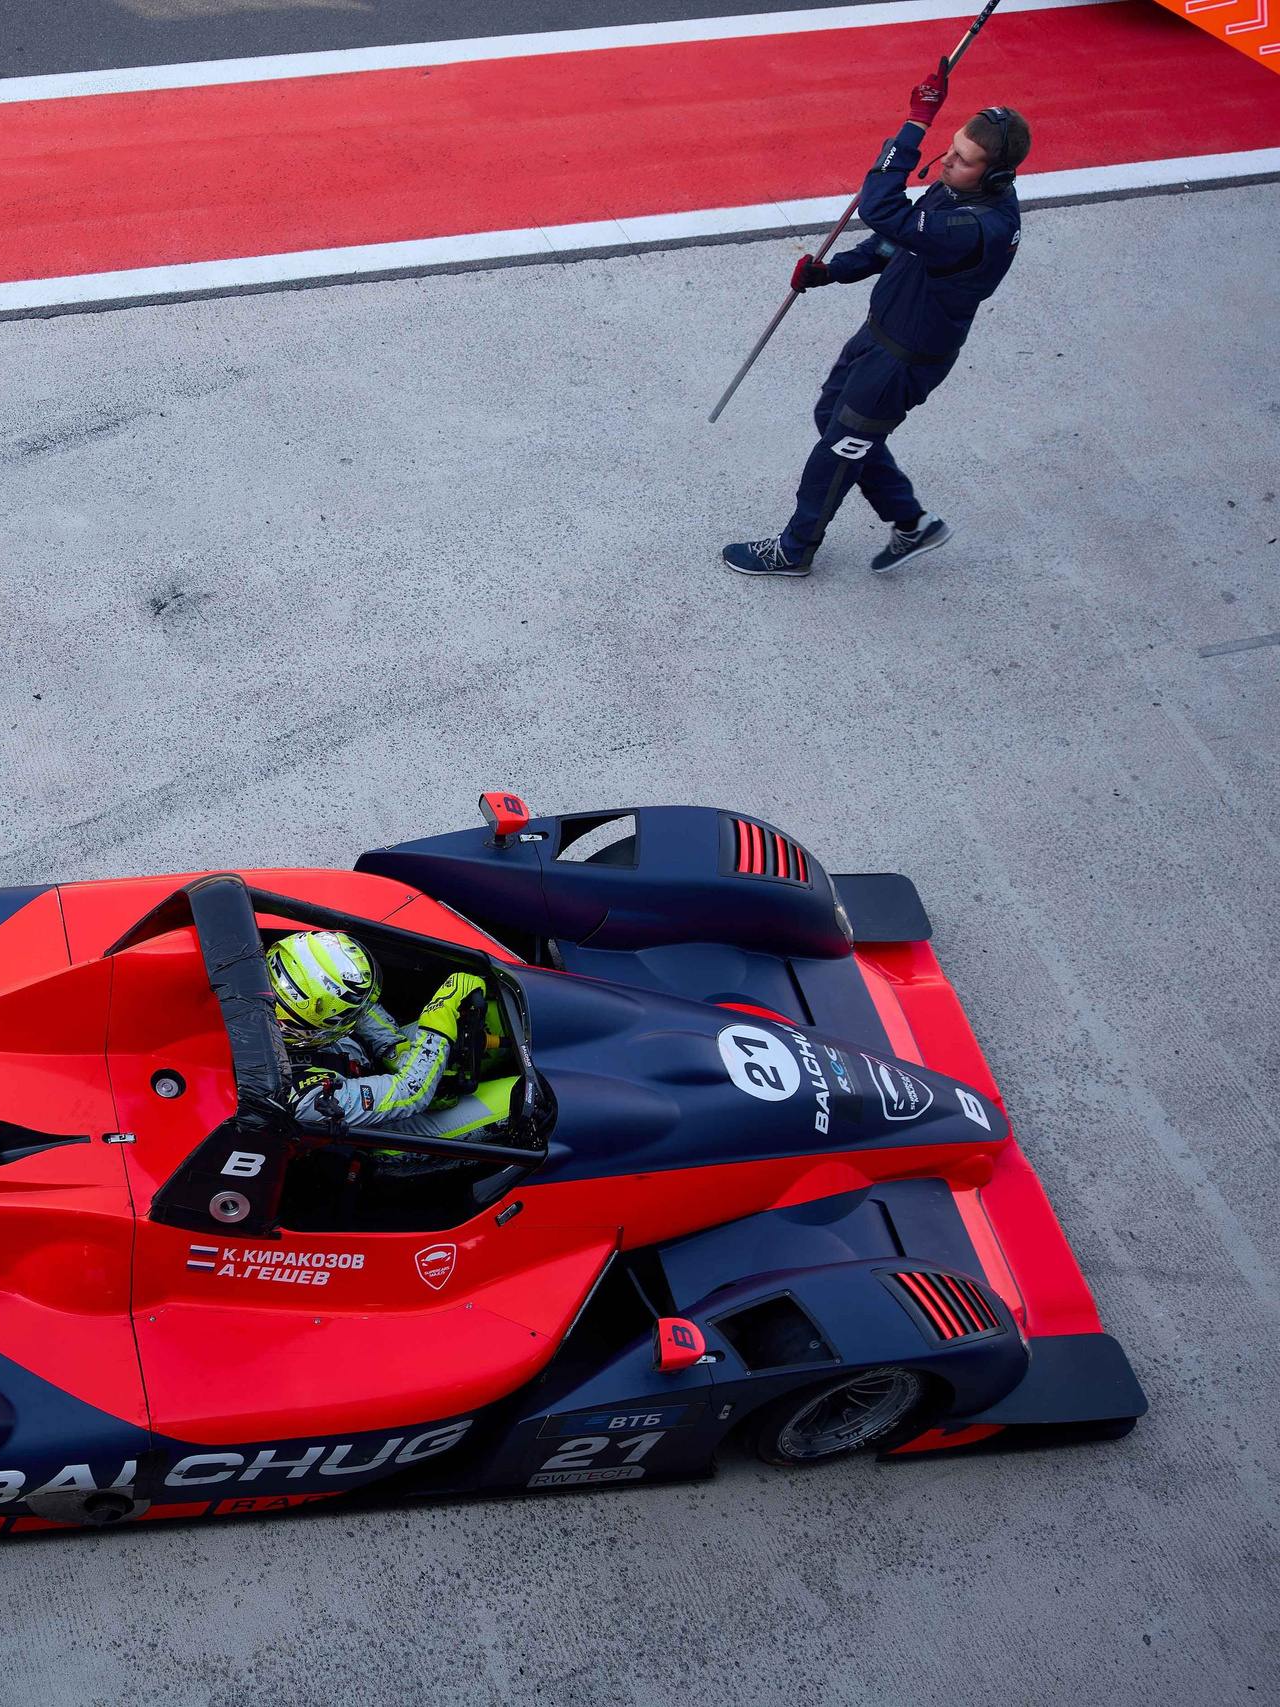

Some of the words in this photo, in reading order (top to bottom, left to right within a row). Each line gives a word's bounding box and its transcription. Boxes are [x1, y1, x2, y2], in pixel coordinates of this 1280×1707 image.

[830, 435, 874, 460] B
[503, 796, 524, 817] B
[731, 1034, 787, 1092] 21
[954, 1087, 992, 1132] B
[220, 1150, 267, 1178] B
[671, 1324, 697, 1351] B
[540, 1430, 667, 1471] 21
[533, 1467, 634, 1486] RWTECH
